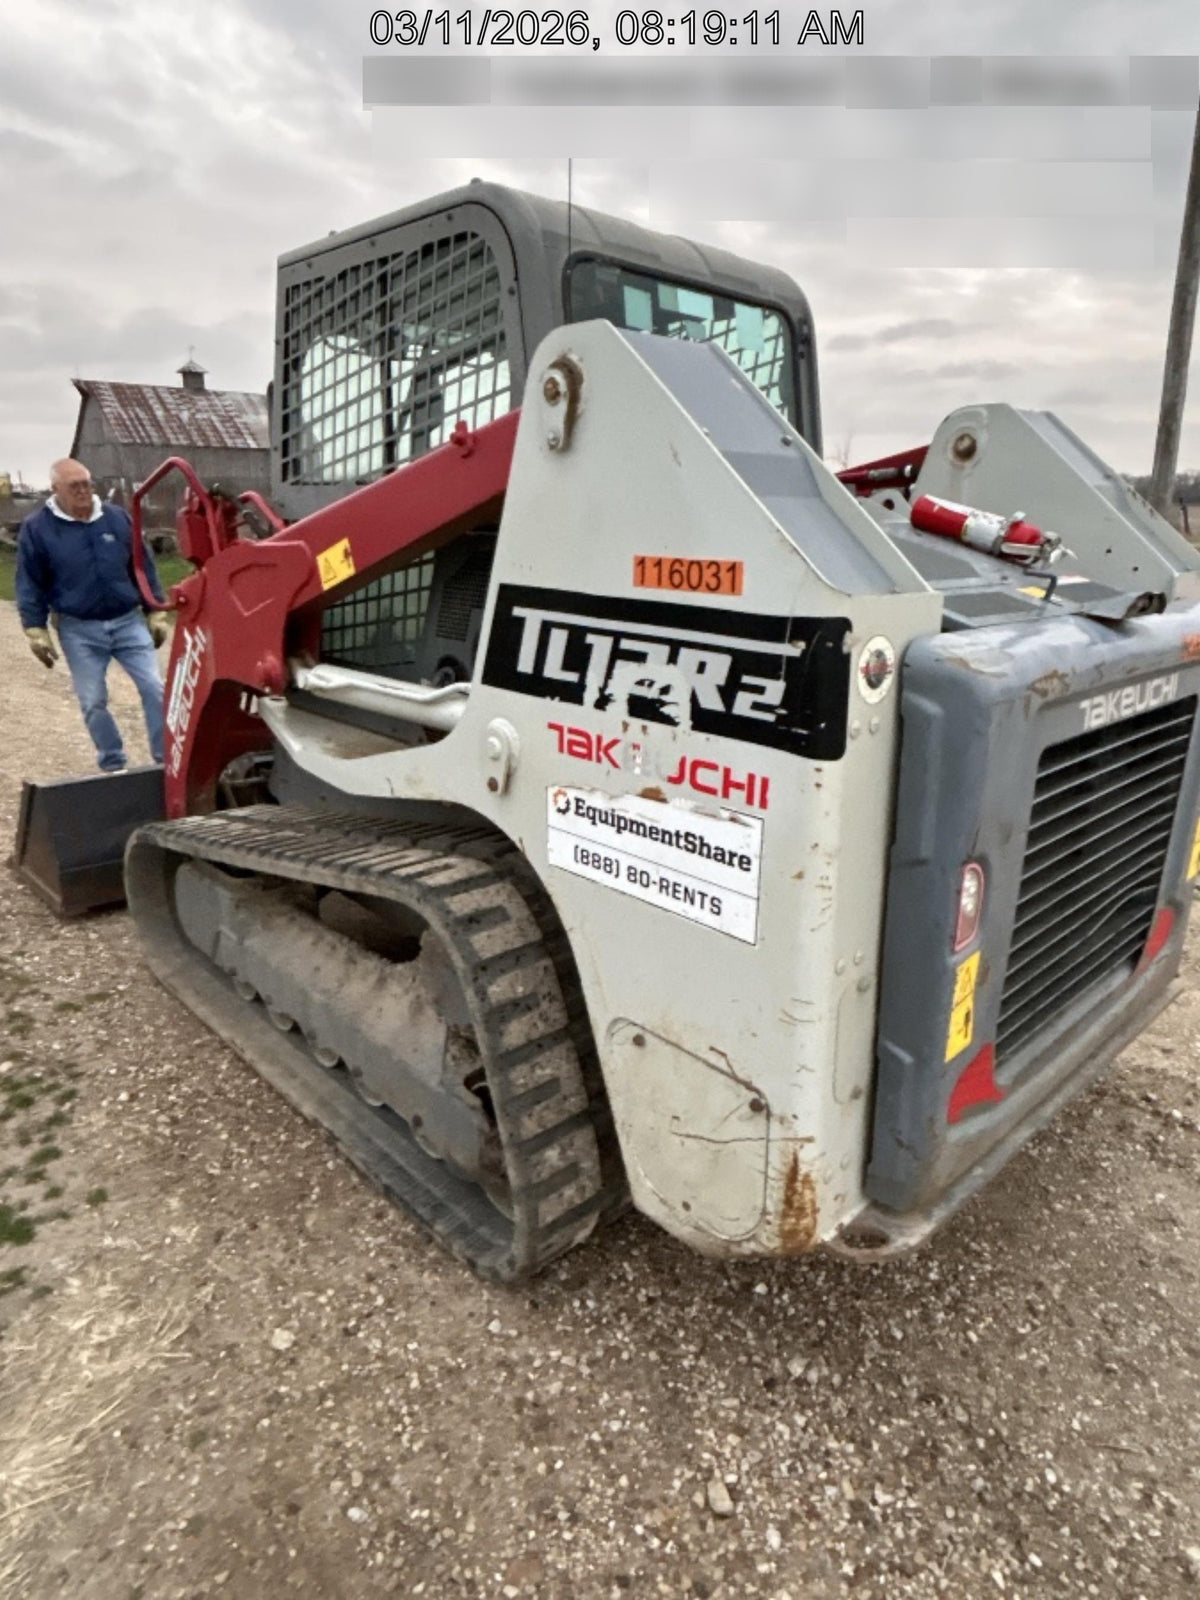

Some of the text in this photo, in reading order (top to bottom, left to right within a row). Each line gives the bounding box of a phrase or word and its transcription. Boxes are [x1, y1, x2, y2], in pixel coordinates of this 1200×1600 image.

[636, 556, 741, 593] 116031
[547, 721, 770, 810] TAKUCHI
[573, 797, 752, 872] EquipmentShare
[573, 844, 723, 916] (888) 80-RENTS
